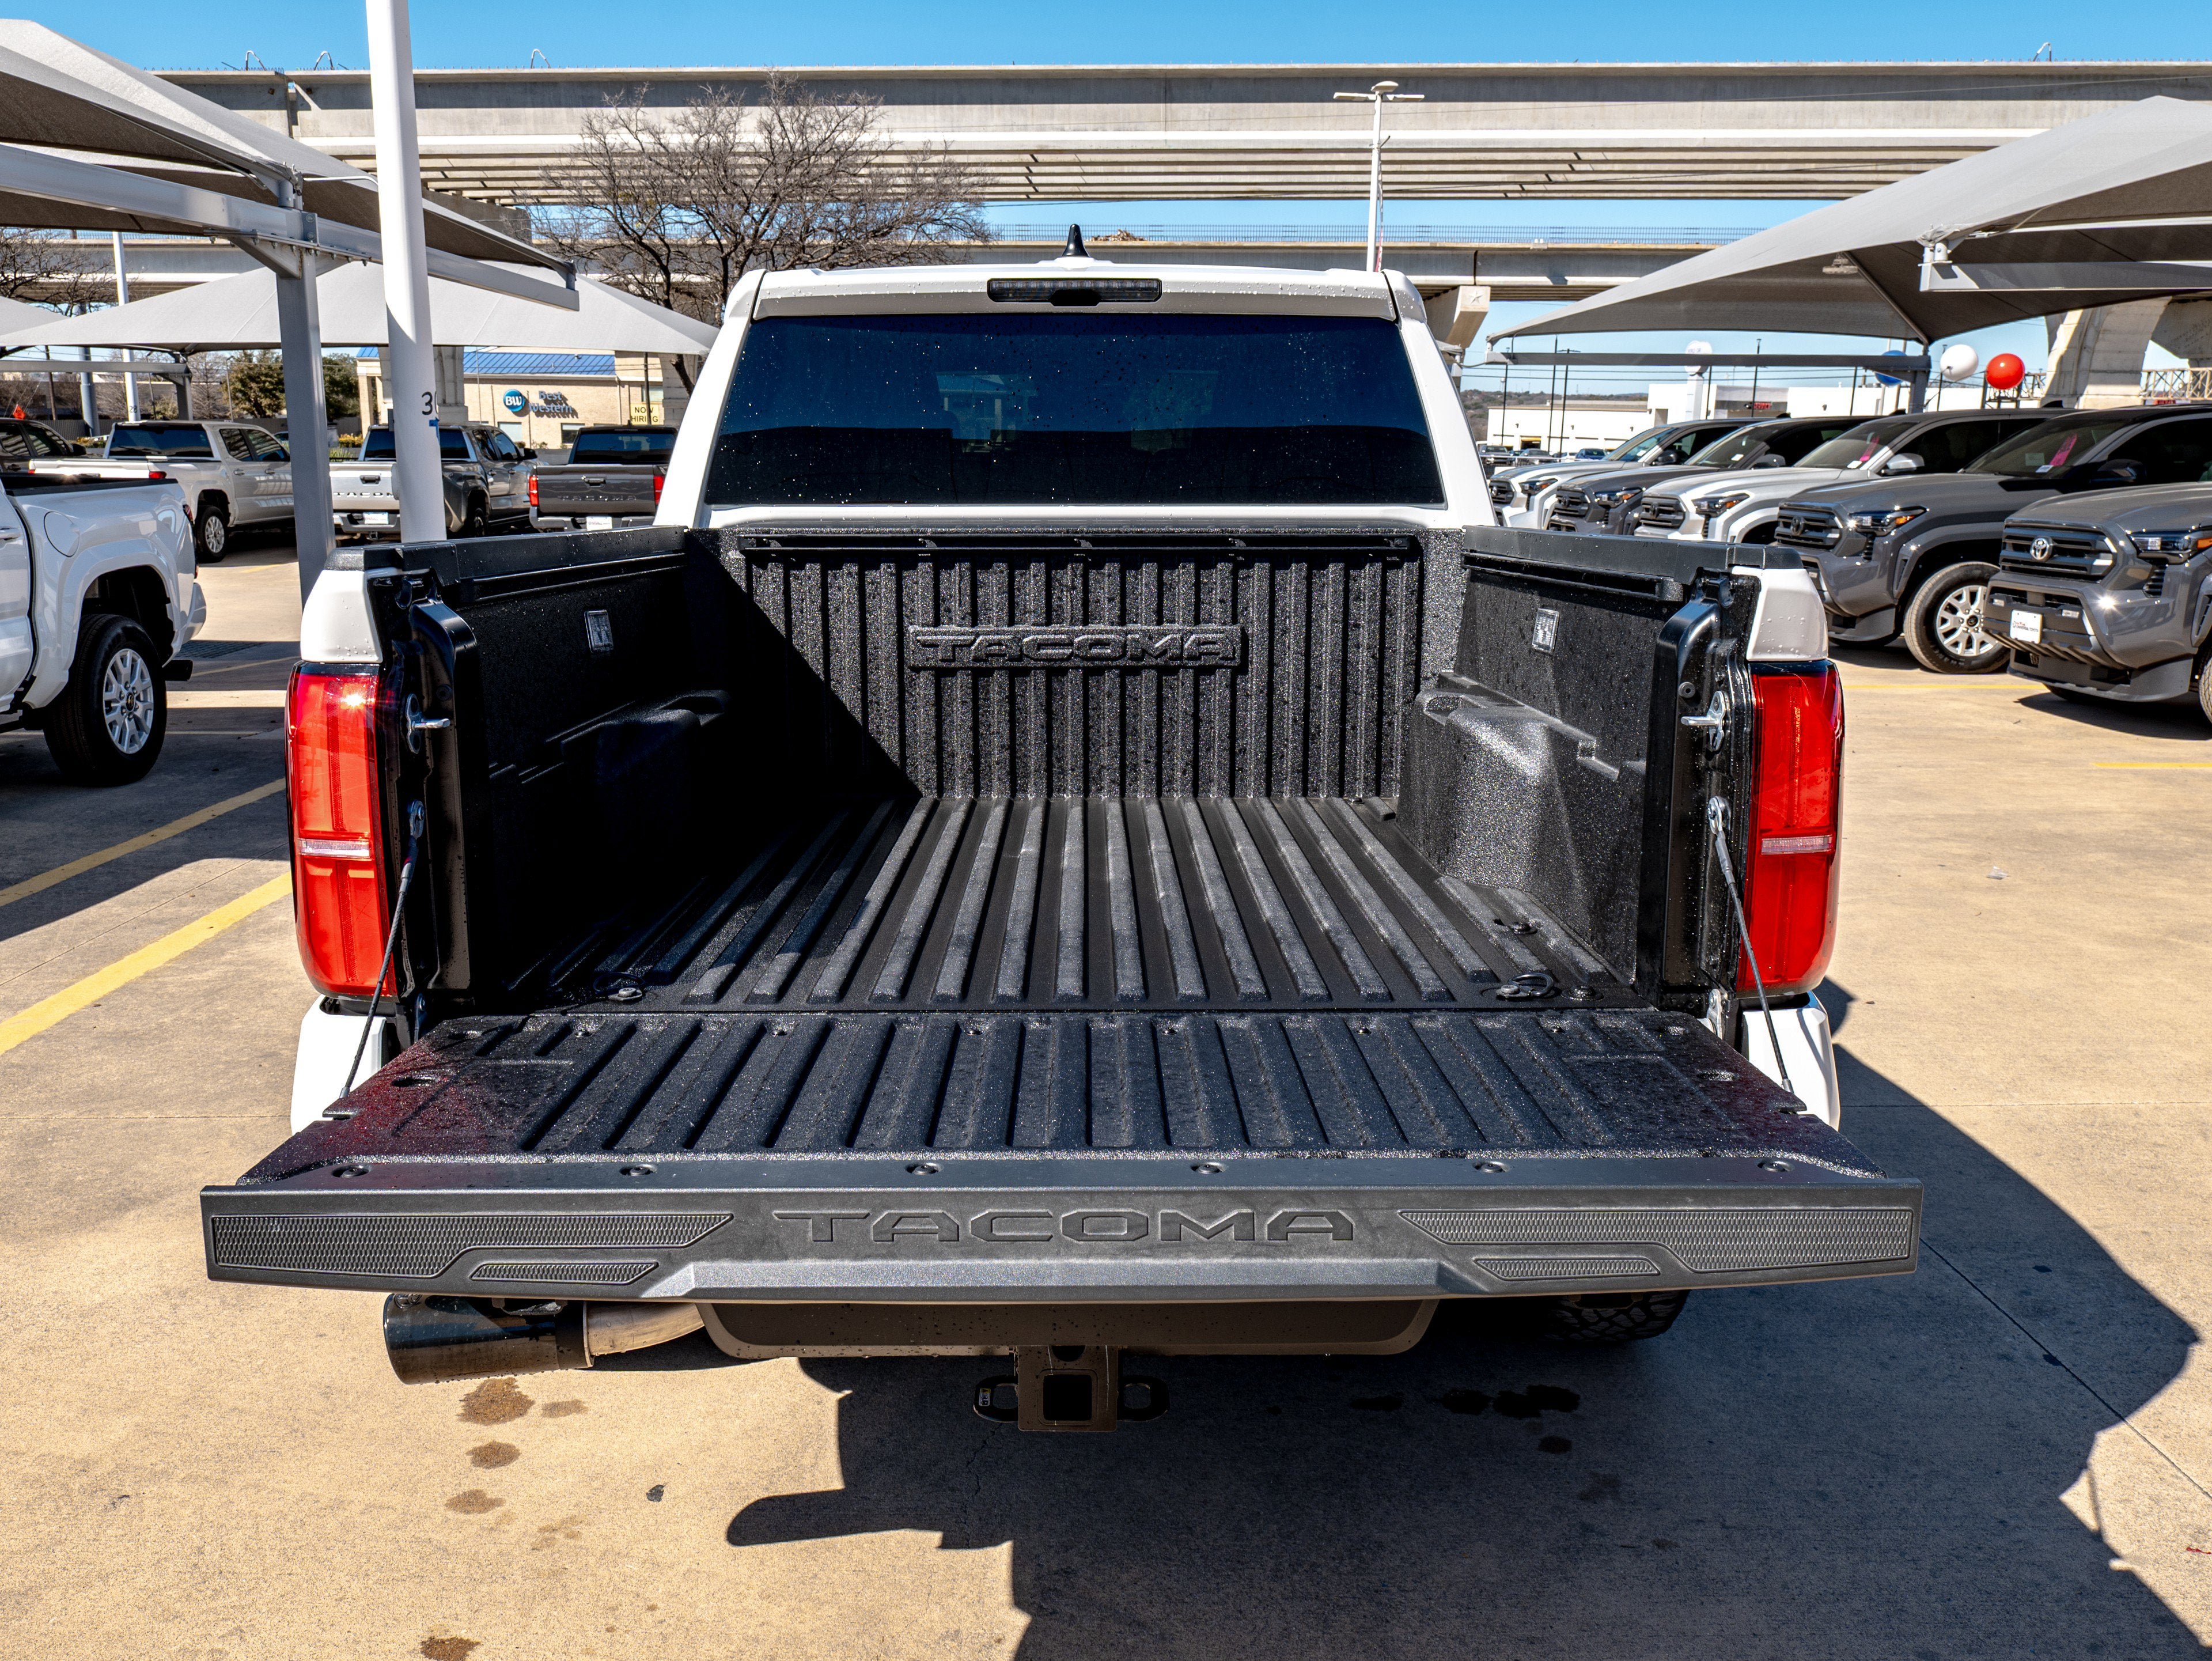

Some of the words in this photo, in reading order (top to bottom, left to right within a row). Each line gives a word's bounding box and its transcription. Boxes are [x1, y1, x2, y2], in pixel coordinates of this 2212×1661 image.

[422, 391, 438, 415] 3
[505, 396, 522, 406] BW
[539, 391, 562, 400] Best
[529, 403, 573, 413] Western
[916, 634, 1236, 663] TACOMA
[772, 1209, 1355, 1242] TACOMA
